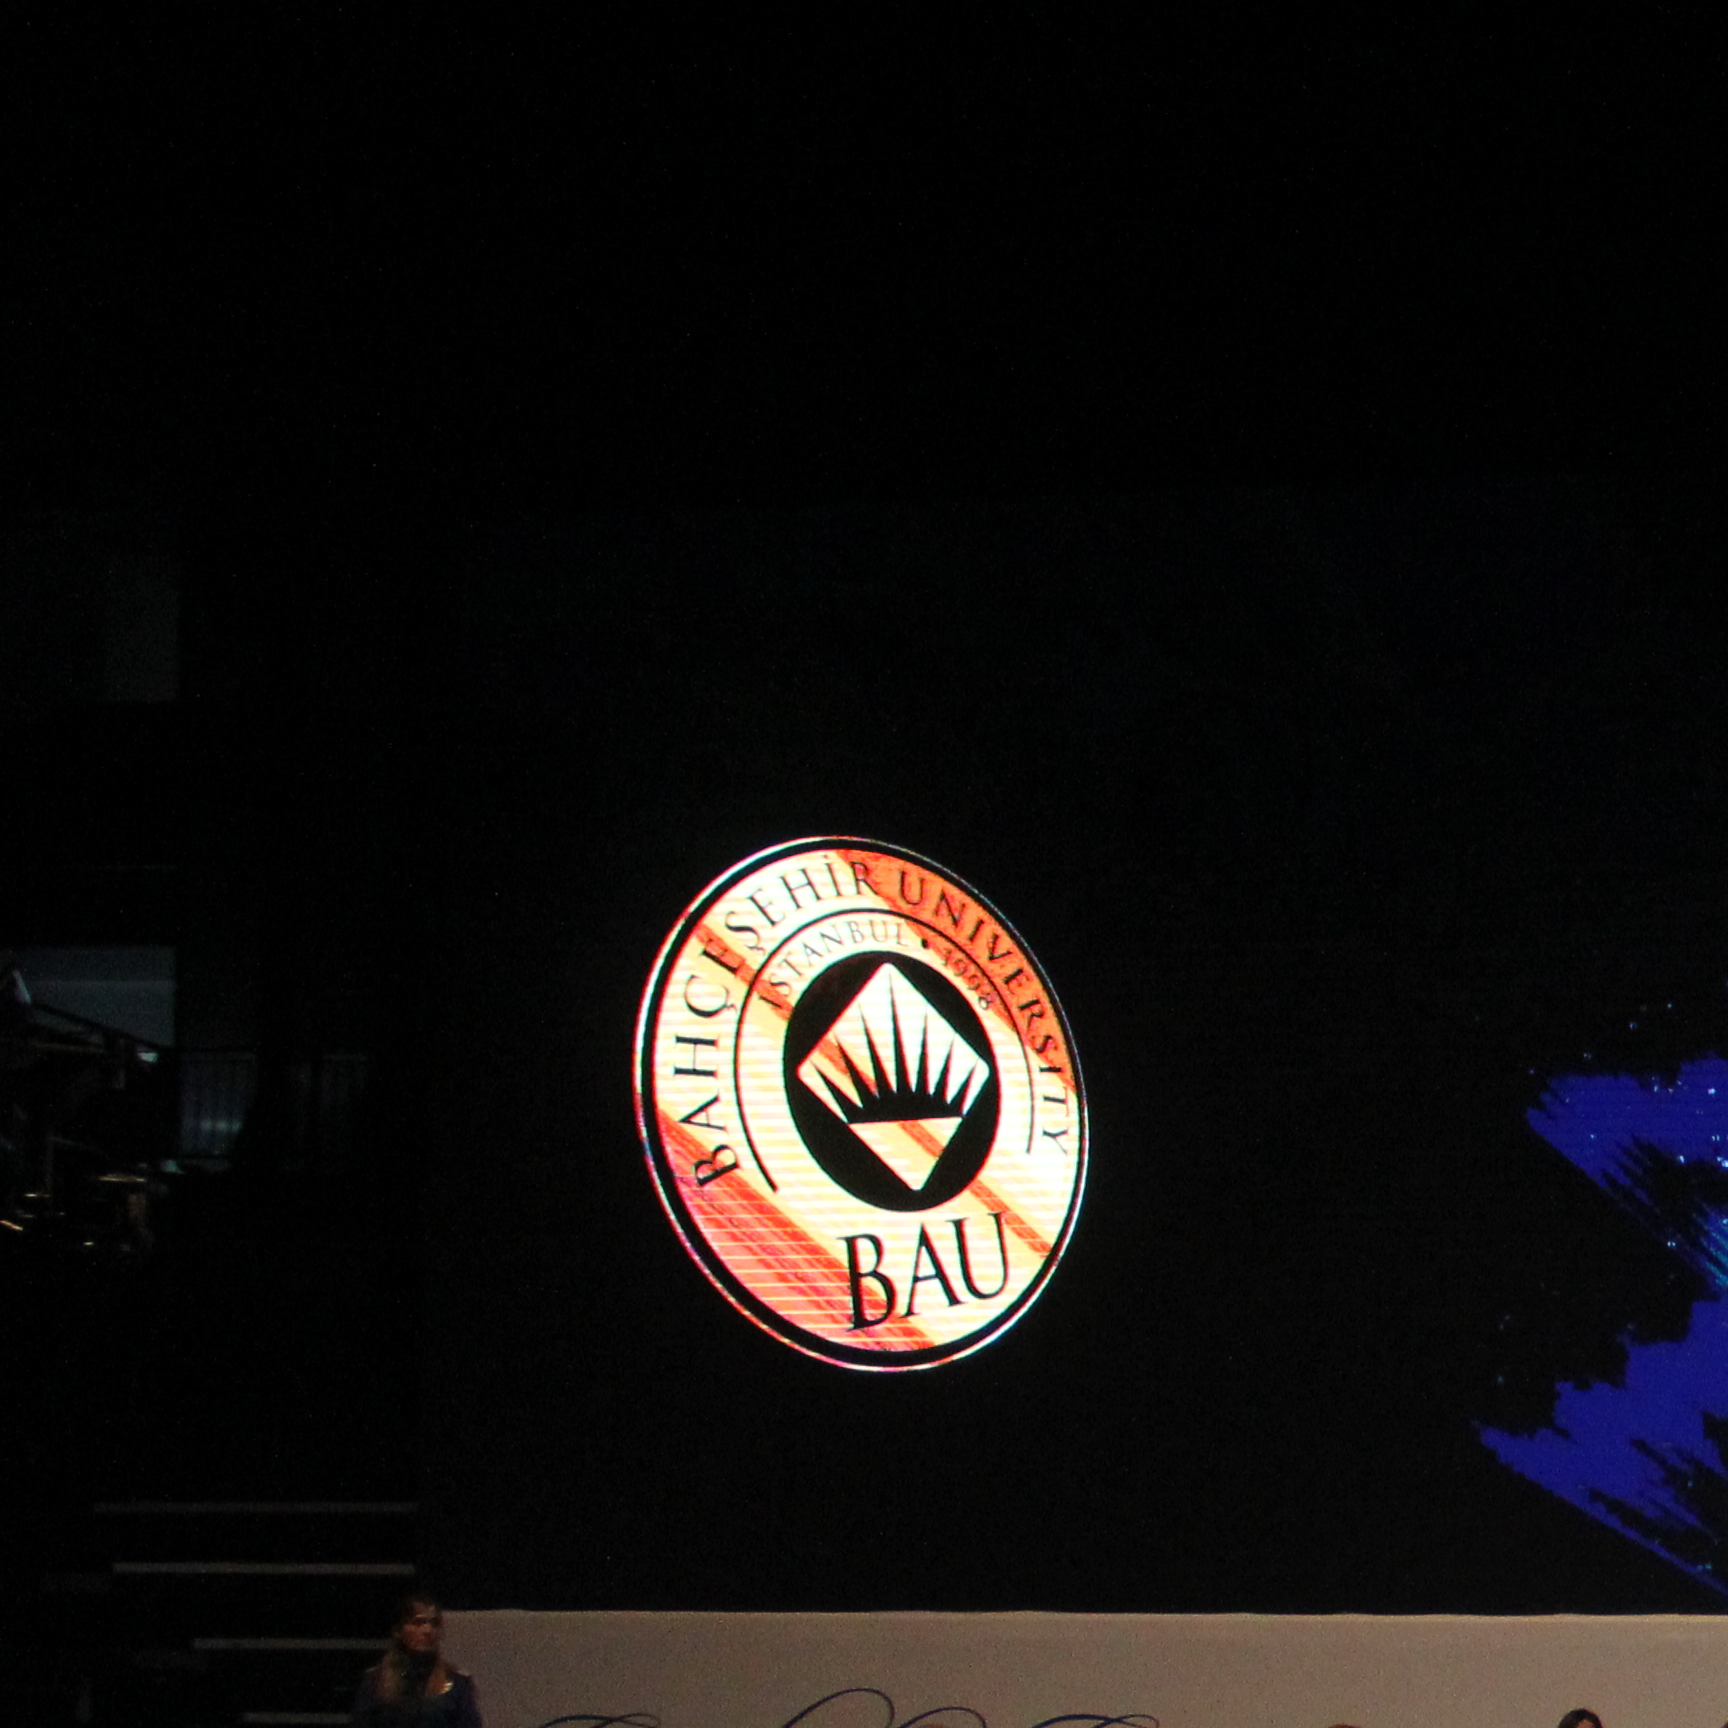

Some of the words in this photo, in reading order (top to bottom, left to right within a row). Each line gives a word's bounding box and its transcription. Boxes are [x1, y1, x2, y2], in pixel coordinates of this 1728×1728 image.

[899, 870, 1069, 1155] UNIVERSITY
[940, 948, 993, 1010] 1998
[838, 1211, 1011, 1332] BAU
